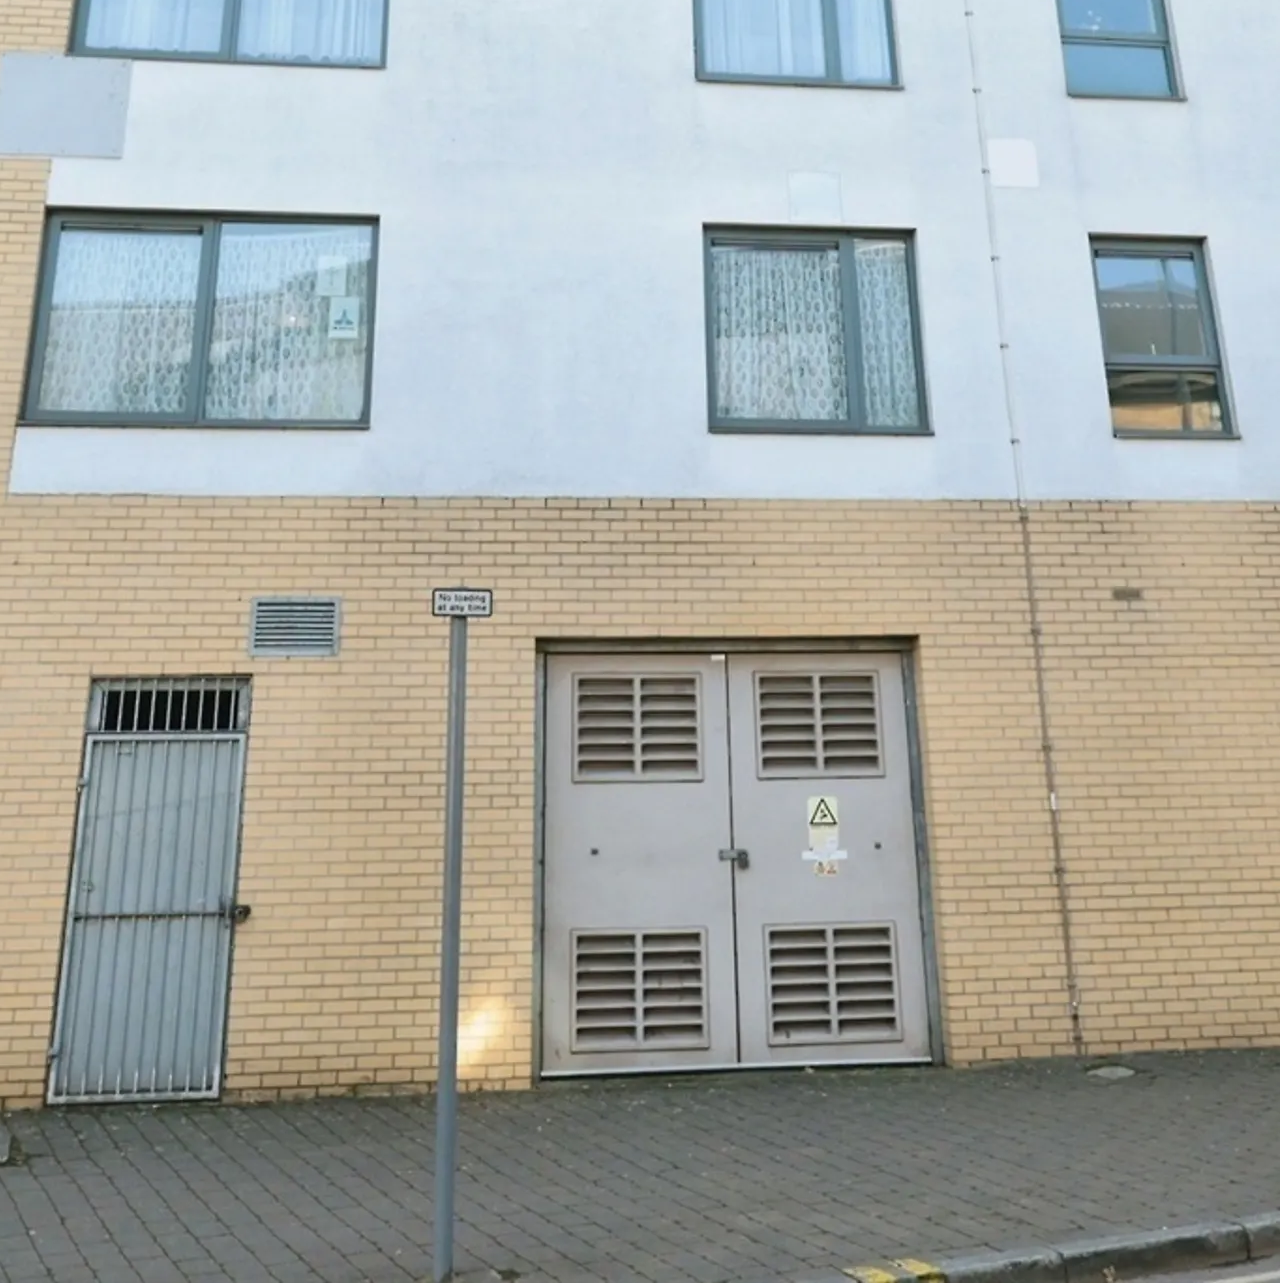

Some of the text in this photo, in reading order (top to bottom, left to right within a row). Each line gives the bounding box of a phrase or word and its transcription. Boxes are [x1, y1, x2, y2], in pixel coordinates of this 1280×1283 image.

[439, 593, 486, 604] No loading
[449, 605, 465, 613] any
[468, 603, 487, 612] time
